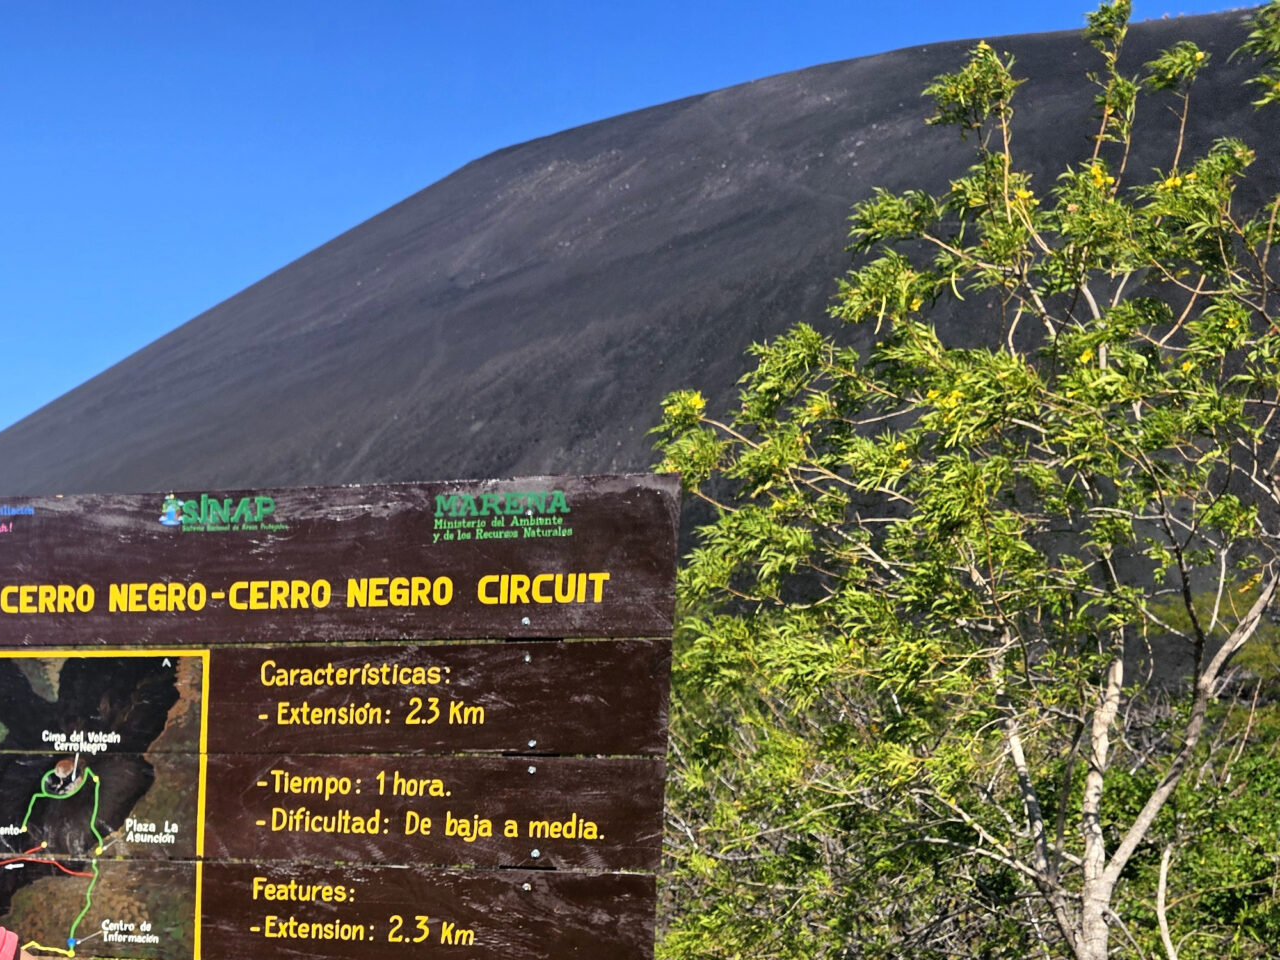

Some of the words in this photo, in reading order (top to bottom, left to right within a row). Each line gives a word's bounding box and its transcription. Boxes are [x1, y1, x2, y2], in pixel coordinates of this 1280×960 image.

[182, 494, 275, 524] SINAP
[434, 489, 570, 517] MARENA
[433, 532, 440, 543] y
[443, 530, 454, 540] de
[457, 529, 471, 540] los
[475, 528, 518, 539] Recursos
[523, 526, 573, 538] Naturales
[434, 518, 486, 529] Ministerio
[491, 516, 505, 527] del
[510, 516, 563, 527] Ambiente
[0, 584, 95, 614] CERRO
[347, 576, 454, 608] NEGRO
[477, 572, 610, 605] CIRCUIT
[260, 659, 451, 687] Características:
[405, 697, 441, 725] 2.3
[449, 700, 485, 725] Km
[42, 730, 66, 742] Cima
[70, 730, 84, 742] del
[393, 772, 452, 798] hora.
[125, 818, 156, 832] Plaza
[164, 820, 179, 833] La
[405, 810, 431, 836] De
[445, 811, 492, 843] baja
[504, 818, 519, 838] a
[528, 812, 605, 841] media.
[252, 876, 355, 903] Features:
[101, 919, 135, 931] Centro
[140, 920, 152, 932] de
[103, 930, 159, 944] Información
[388, 914, 430, 943] 2.3
[440, 921, 475, 946] Km
